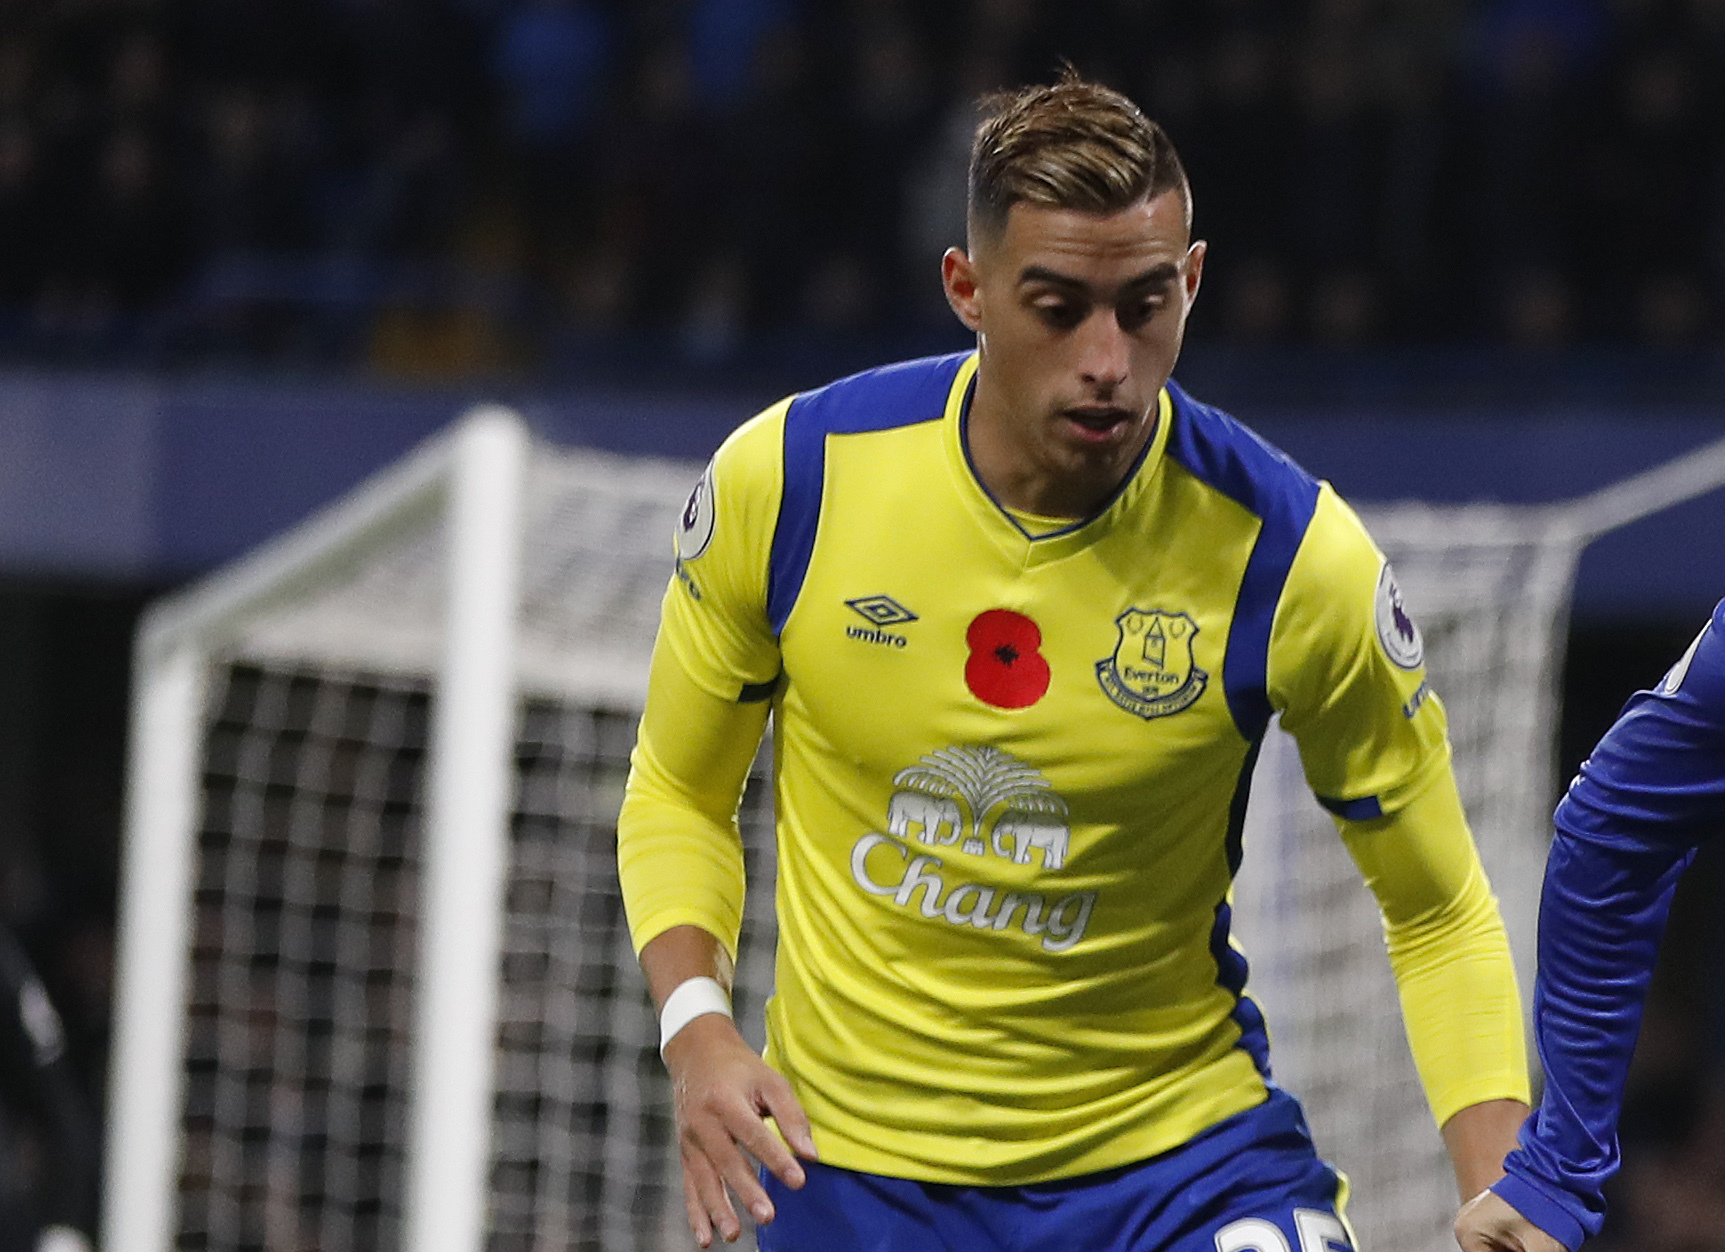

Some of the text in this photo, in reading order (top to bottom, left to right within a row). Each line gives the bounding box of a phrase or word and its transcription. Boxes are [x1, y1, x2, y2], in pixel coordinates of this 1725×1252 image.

[847, 625, 907, 648] umbro
[1125, 665, 1180, 684] Everton
[850, 832, 1098, 952] Chang
